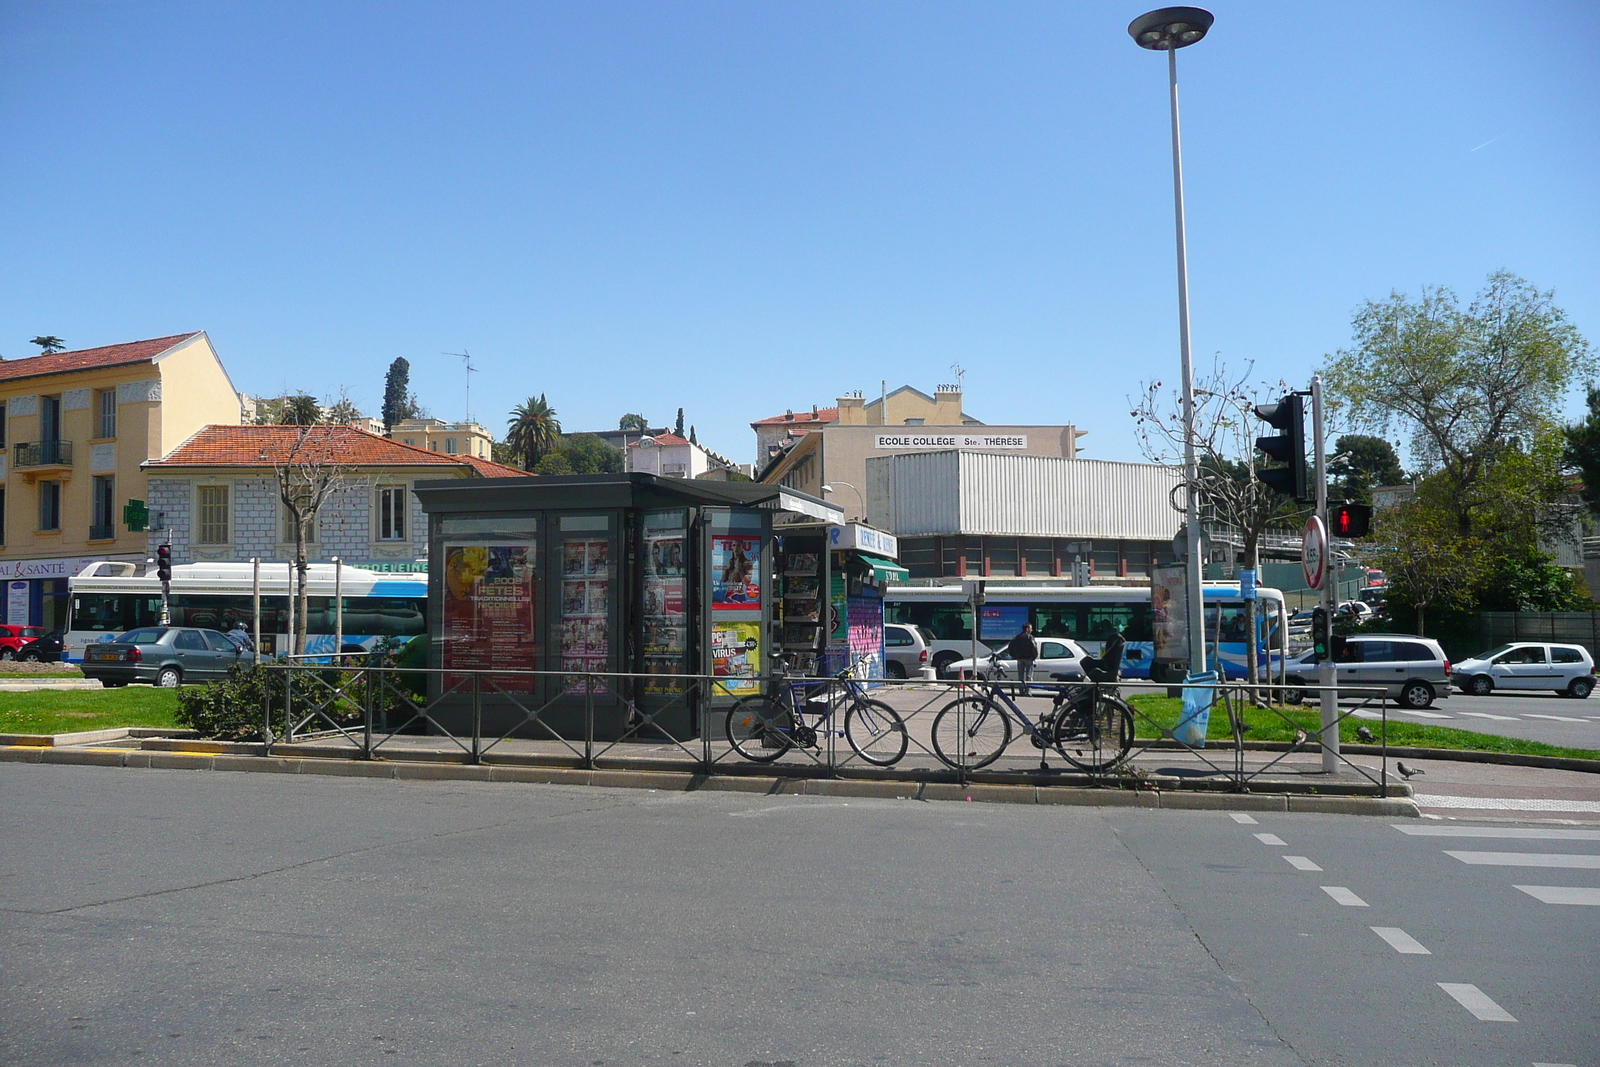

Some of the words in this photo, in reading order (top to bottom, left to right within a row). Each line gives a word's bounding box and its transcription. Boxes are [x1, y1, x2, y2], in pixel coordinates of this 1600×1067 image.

[879, 437, 910, 446] ÉCOLE
[14, 561, 26, 578] &
[27, 562, 66, 575] SANTÉ
[478, 583, 524, 596] FÊTES
[712, 632, 722, 643] PC
[712, 648, 737, 658] VIRUS
